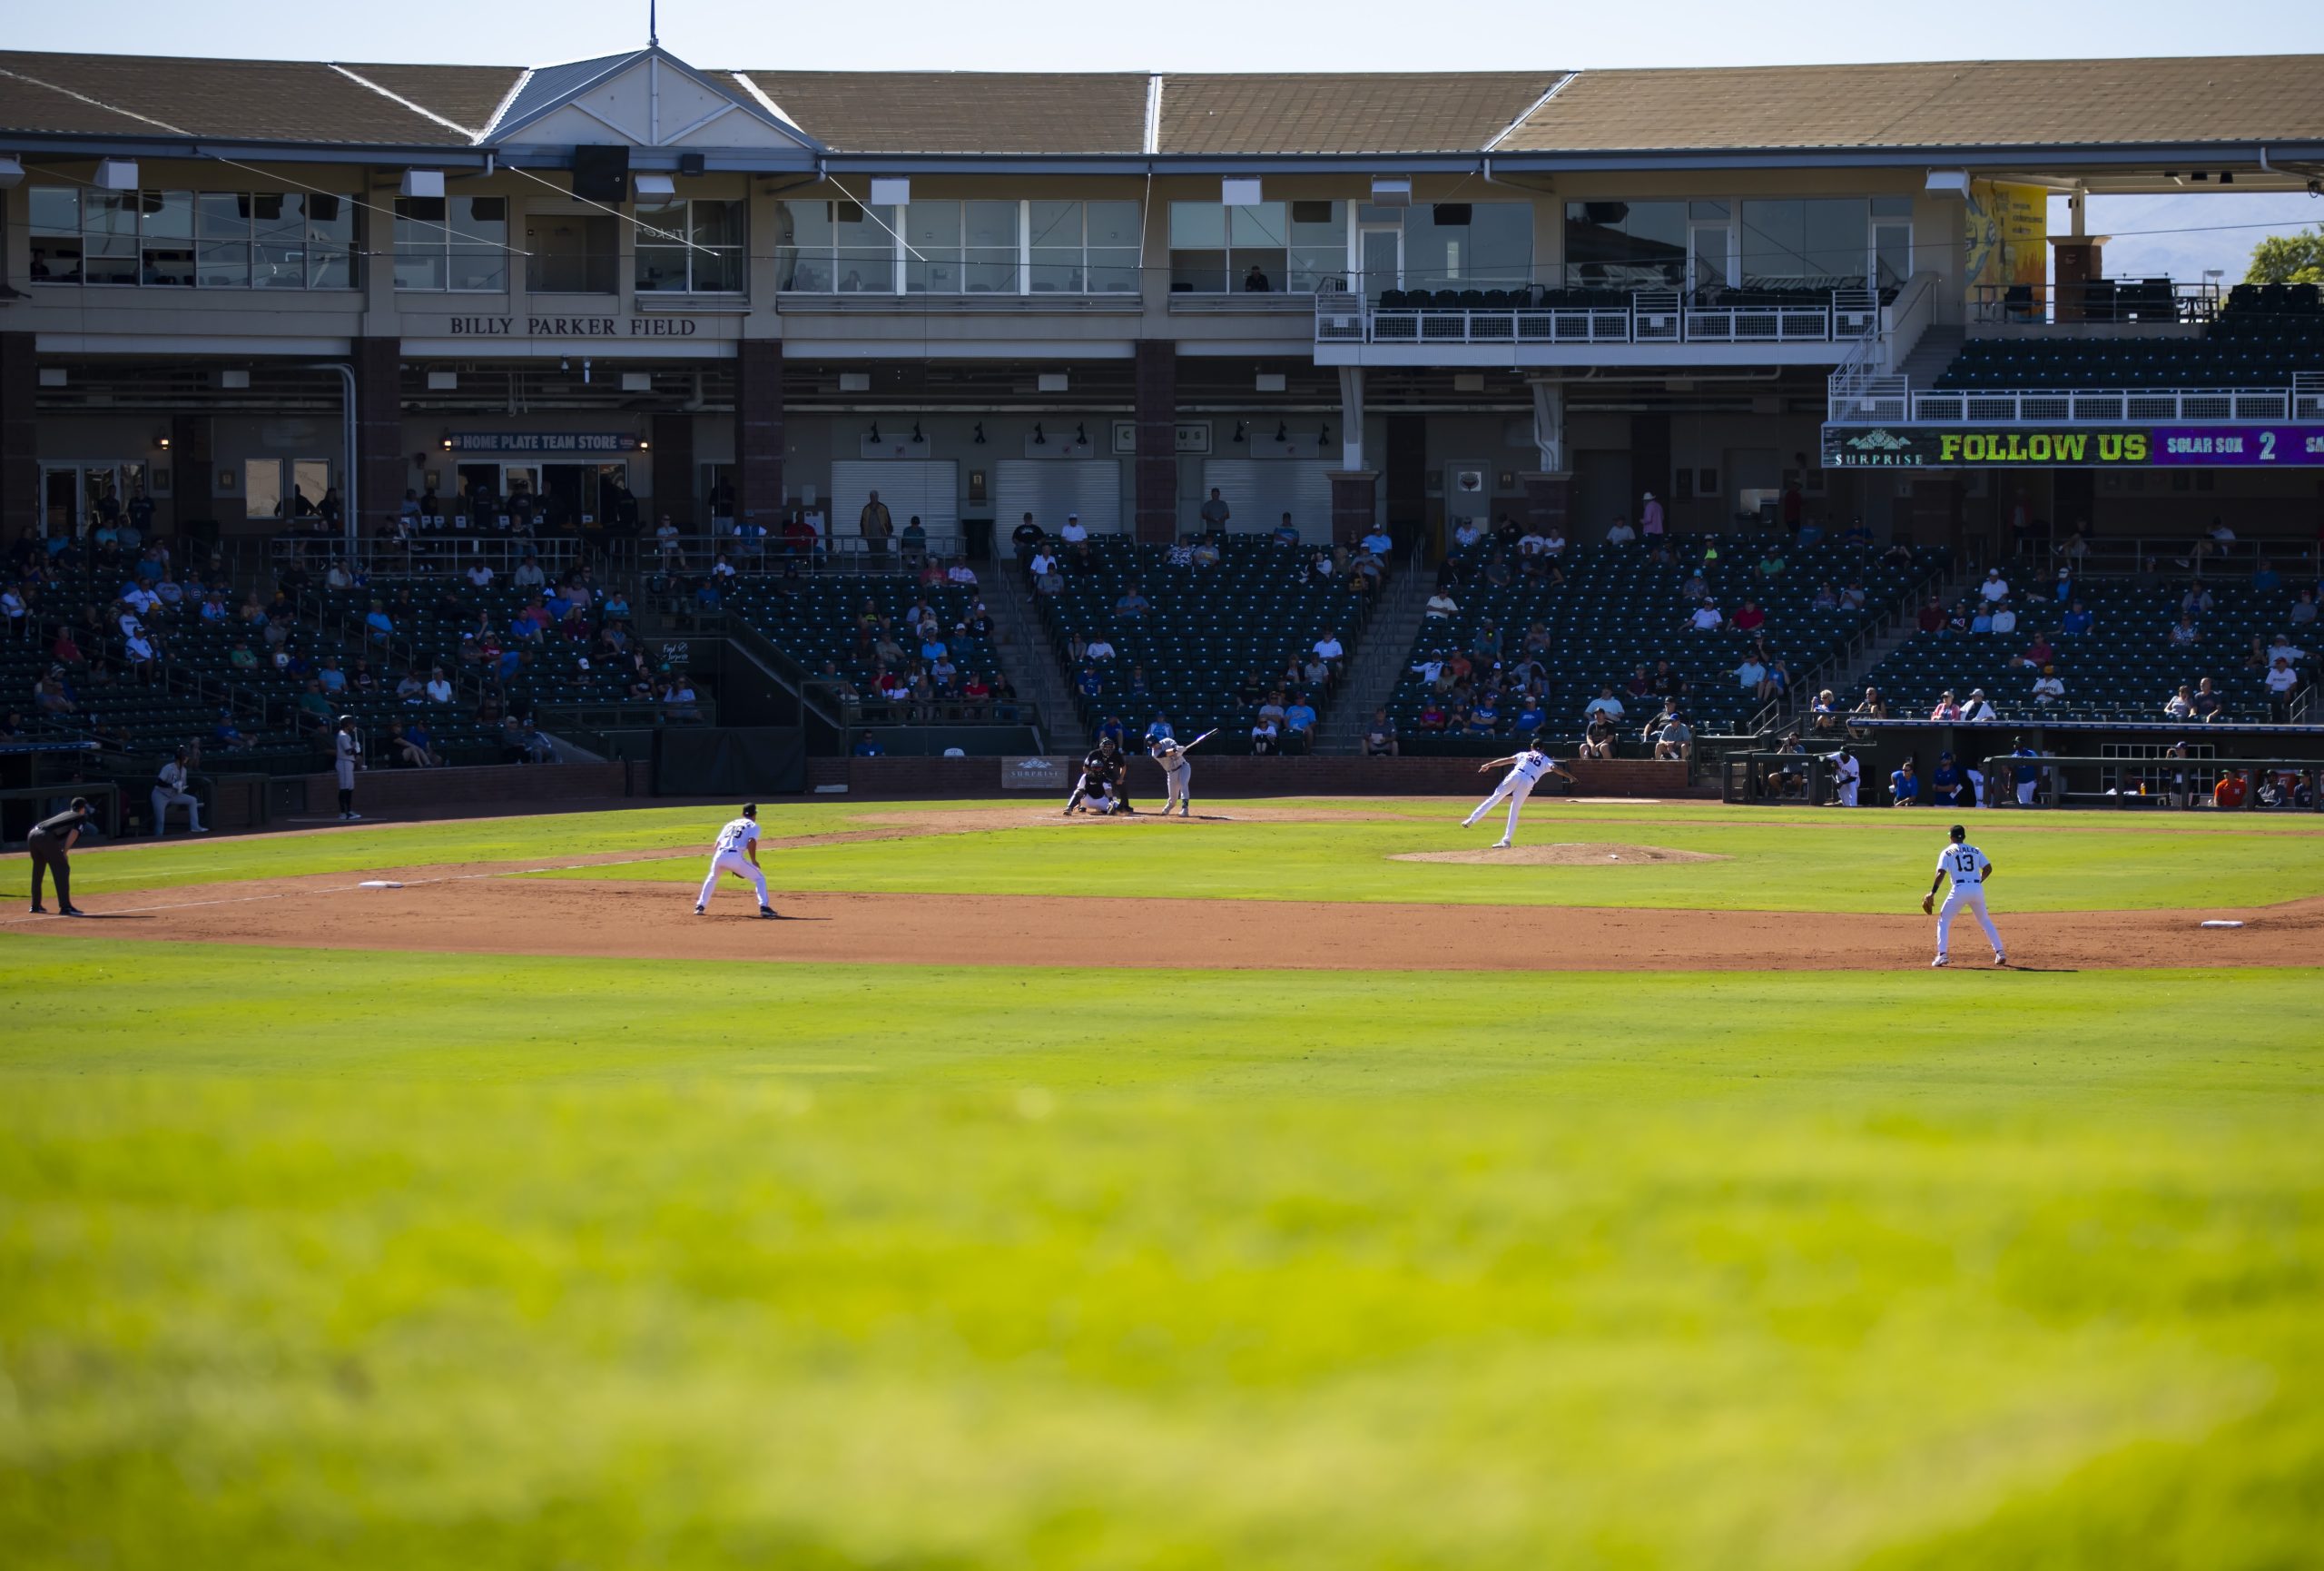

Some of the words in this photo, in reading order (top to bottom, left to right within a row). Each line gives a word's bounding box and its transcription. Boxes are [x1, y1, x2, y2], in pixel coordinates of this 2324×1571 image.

[450, 318, 513, 334] BILLY
[527, 319, 616, 335] PARKER
[630, 320, 695, 335] FIELD
[463, 436, 498, 449] HOME
[501, 436, 538, 449] PLATE
[542, 436, 576, 449] TEAM
[578, 436, 616, 449] STORE
[1940, 434, 2087, 460] FOLLOW
[2098, 434, 2147, 460] US
[2167, 437, 2211, 453] SOLAR
[2216, 437, 2244, 453] SOX
[2259, 431, 2276, 459] 2
[1836, 454, 1923, 465] SURPRISE
[1526, 754, 1541, 766] 36
[1955, 855, 1974, 872] 13
